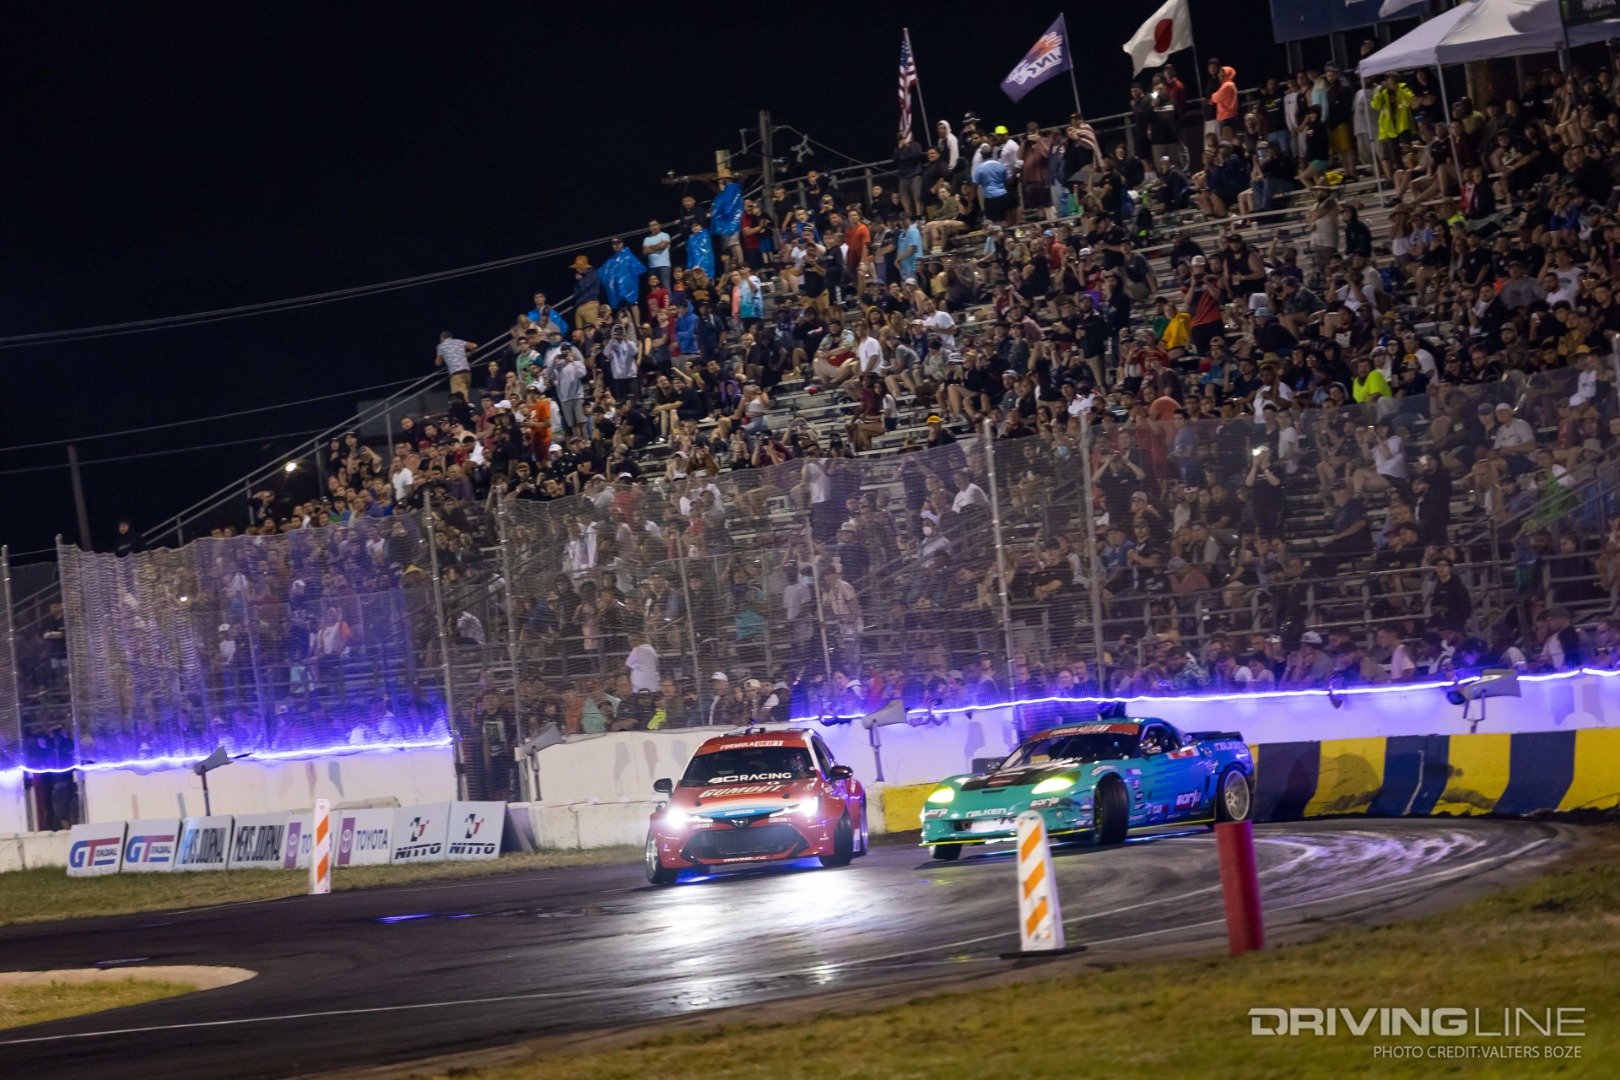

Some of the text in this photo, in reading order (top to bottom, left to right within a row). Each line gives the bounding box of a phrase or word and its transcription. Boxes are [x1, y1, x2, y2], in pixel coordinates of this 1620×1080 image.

[719, 742, 755, 750] FORMULA
[740, 772, 792, 782] RACING
[698, 784, 787, 798] GUMOUT
[965, 807, 1007, 818] FALKEN
[355, 828, 388, 851] TOYOTA
[69, 837, 121, 868] GT RADIAL
[125, 835, 176, 863] GT
[394, 842, 442, 860] NITTO
[449, 842, 496, 855] NITTO
